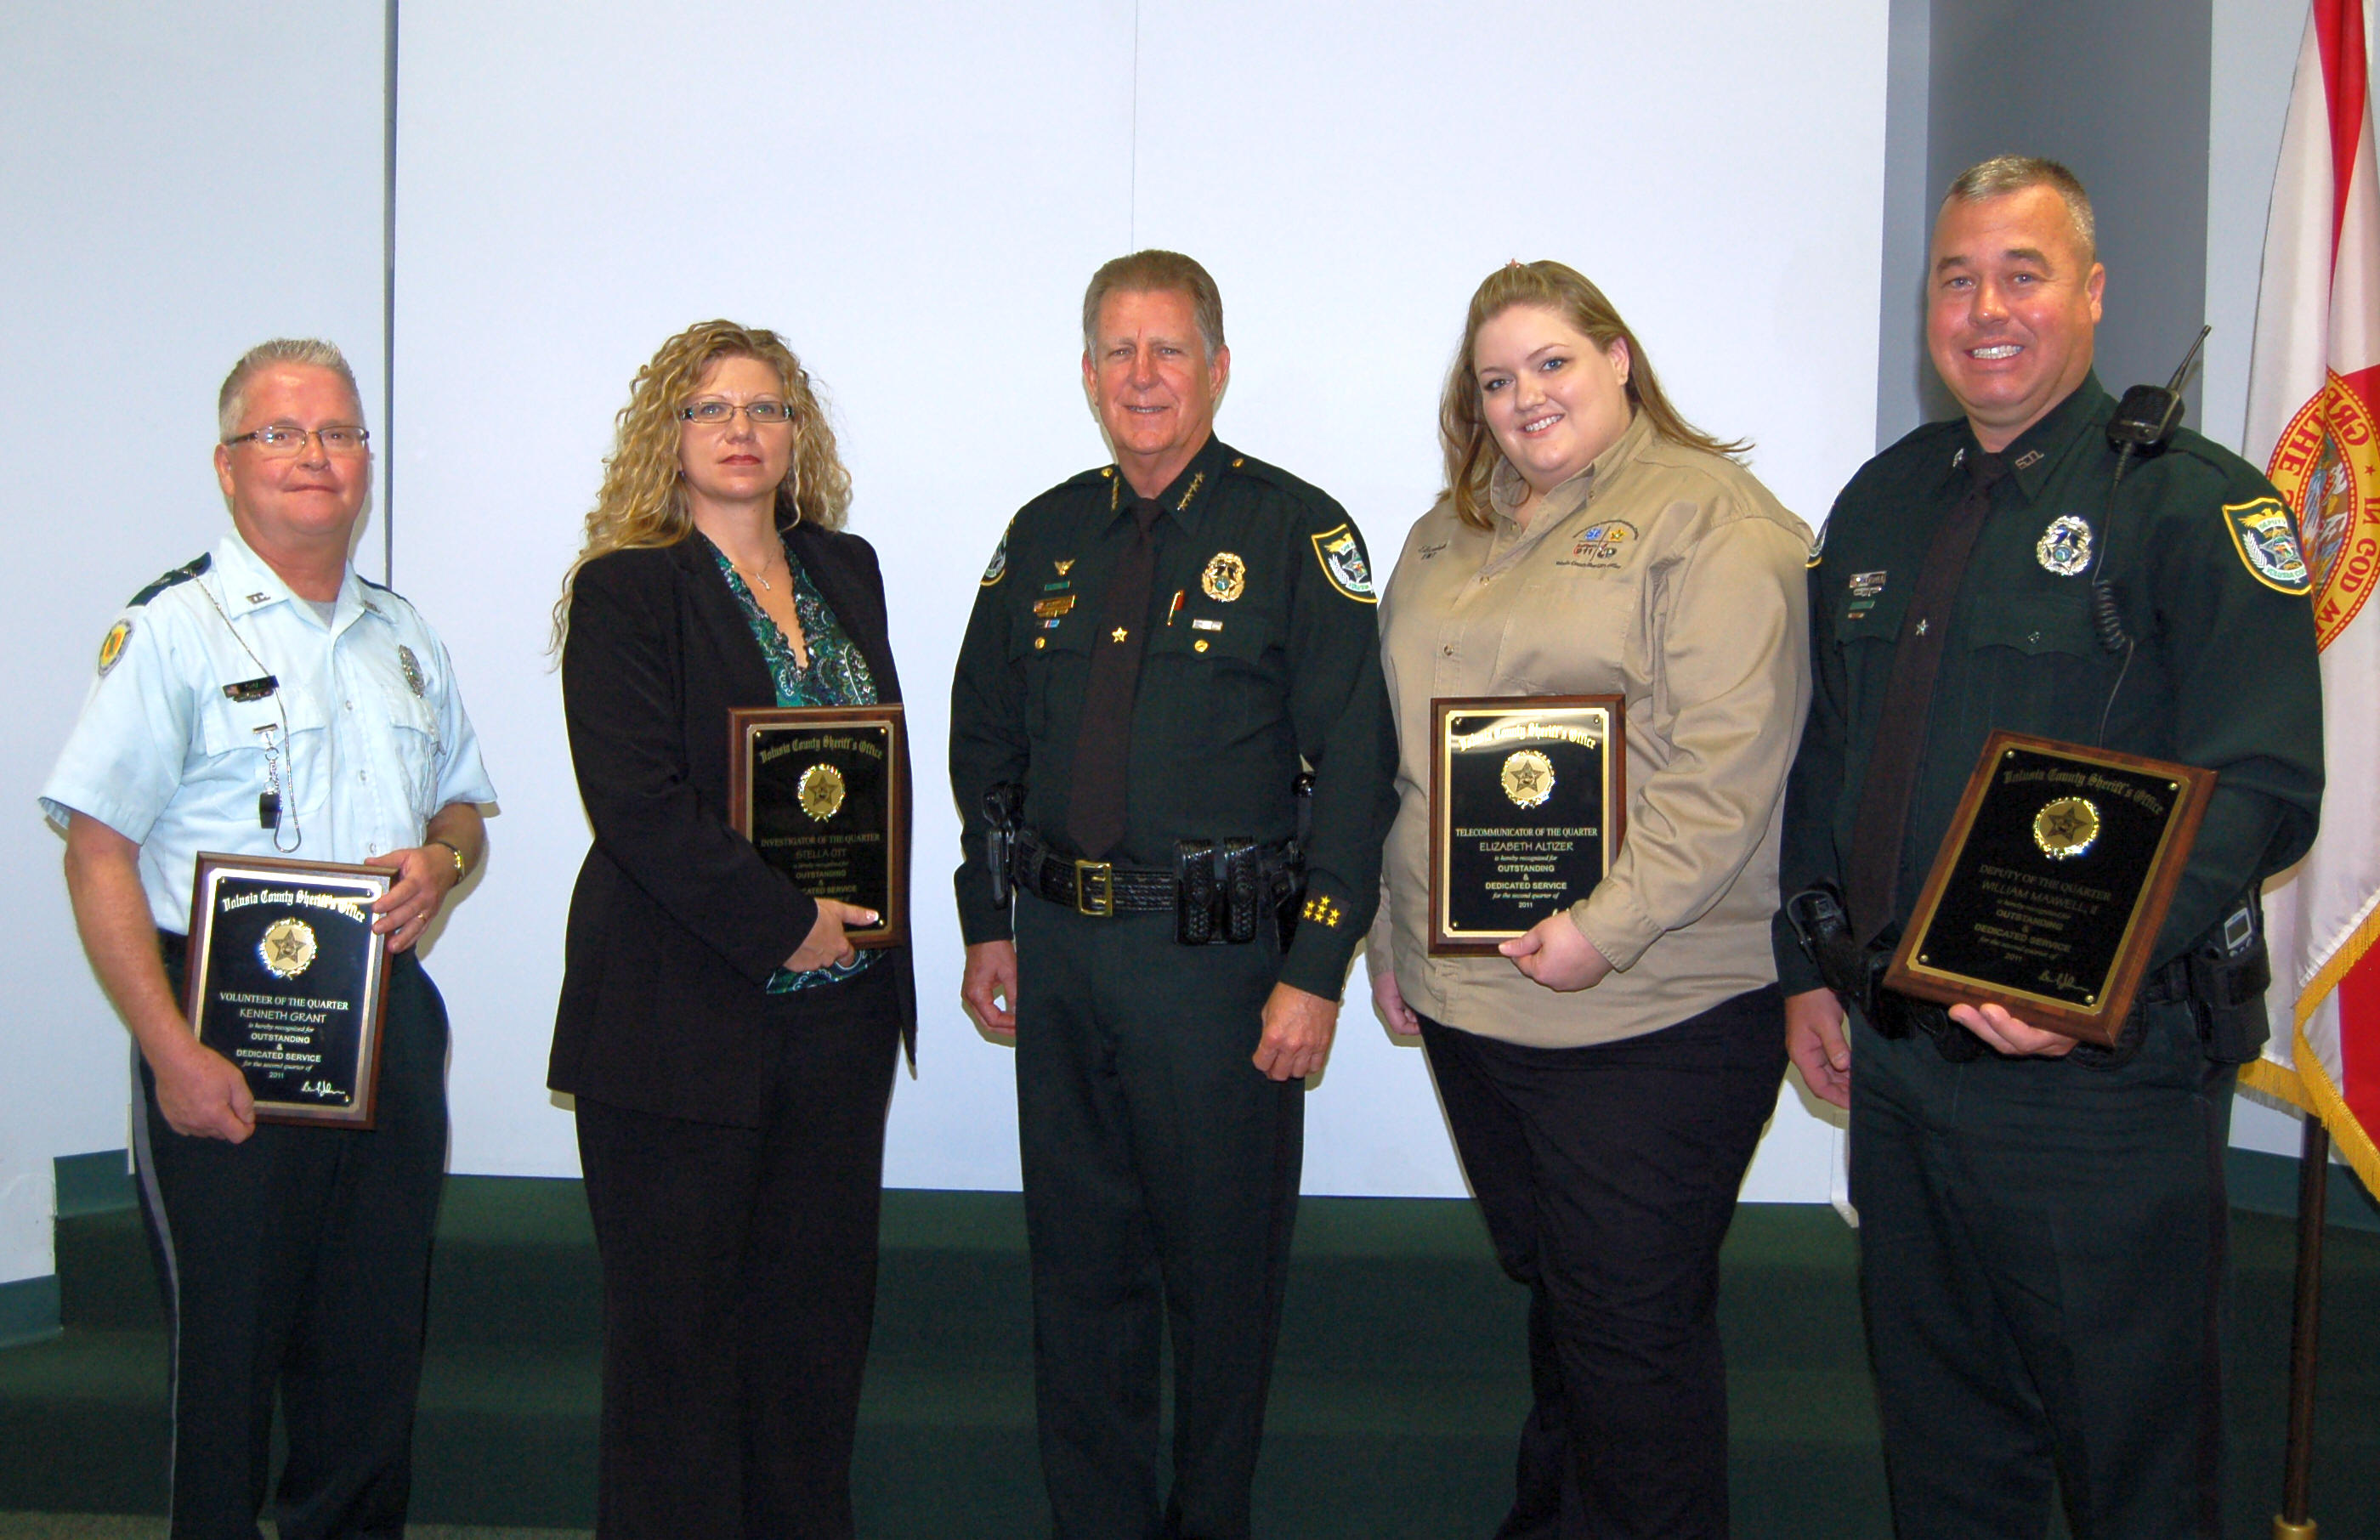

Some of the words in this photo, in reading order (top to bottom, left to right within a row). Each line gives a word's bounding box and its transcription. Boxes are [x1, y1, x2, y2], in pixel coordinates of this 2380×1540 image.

[1459, 733, 1492, 752] Volusia
[1493, 725, 1526, 739] County
[1527, 722, 1567, 739] Sheriff's
[1569, 729, 1596, 750] Office
[760, 745, 790, 763] Volusia
[792, 737, 821, 751] County
[823, 734, 857, 751] Sheriff's
[858, 740, 883, 760] Office
[2047, 768, 2086, 788] County
[2088, 773, 2133, 799] Sheriff's
[2134, 788, 2164, 814] Office
[761, 836, 816, 846] INVESTIGATOR
[845, 833, 881, 844] QUARTER
[1455, 828, 1533, 836] TELECOMMUNICATOR
[1534, 828, 1545, 836] OF
[1547, 828, 1561, 836] THE
[1562, 828, 1598, 838] QUARTER
[796, 850, 830, 858] STELLA
[830, 849, 847, 858] OTT
[1480, 841, 1533, 852] ELIZABETH
[1535, 841, 1574, 852] ALTIZER
[827, 885, 857, 894] SERVICE
[1979, 863, 2020, 881] DEPUTY
[2021, 872, 2038, 885] OF
[2039, 874, 2060, 889] THE
[2060, 879, 2111, 902] QUARTER
[1981, 880, 2029, 898] WILLIAM
[223, 895, 258, 913] Volusia
[260, 889, 294, 906] County
[296, 889, 337, 910] Sheriff's
[337, 902, 366, 923] Office
[1996, 909, 2064, 931] OUTSTANDING
[1974, 923, 2028, 943] DEDICATED
[2030, 936, 2071, 954] SERVICE
[219, 993, 272, 1005] VOLUNTEER
[275, 996, 287, 1006] OF
[287, 998, 306, 1007] THE
[307, 999, 348, 1011] QUARTER
[240, 1008, 287, 1020] KENNETH
[290, 1011, 326, 1023] GRANT
[251, 1033, 310, 1045] OUTSTANDING
[236, 1049, 284, 1061] DEDICATED
[286, 1052, 321, 1062] SERVICE
[269, 1071, 284, 1079] 2011
